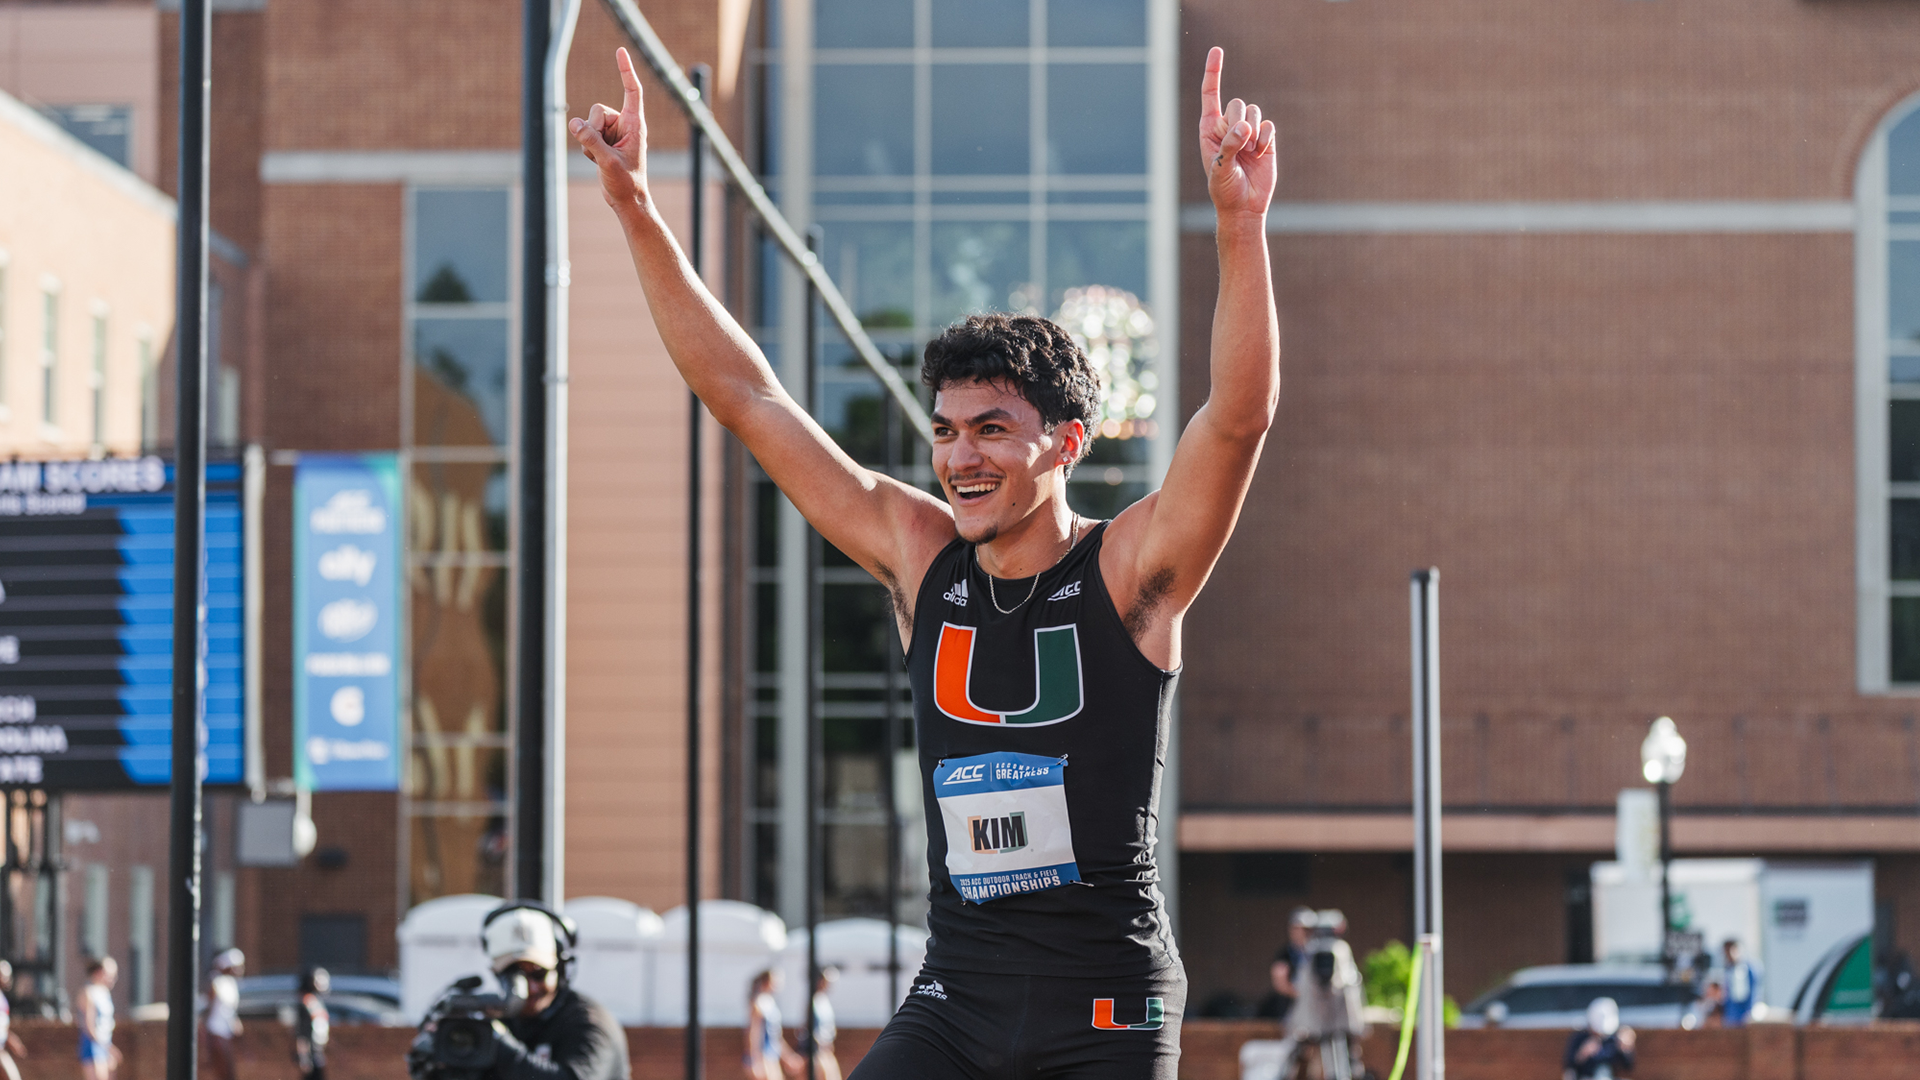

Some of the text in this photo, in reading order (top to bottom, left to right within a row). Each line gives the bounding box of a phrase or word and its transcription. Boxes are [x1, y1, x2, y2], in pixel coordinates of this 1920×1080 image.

[934, 620, 1085, 728] U
[943, 763, 986, 784] ACC
[995, 767, 1050, 780] GREATNESS
[972, 815, 1026, 851] KIM
[961, 875, 1062, 900] CHAMPIONSHIPS
[982, 874, 1011, 885] OUTDOOR
[1011, 872, 1033, 882] TRACK
[1039, 868, 1058, 877] FIELD
[1091, 997, 1165, 1031] U
